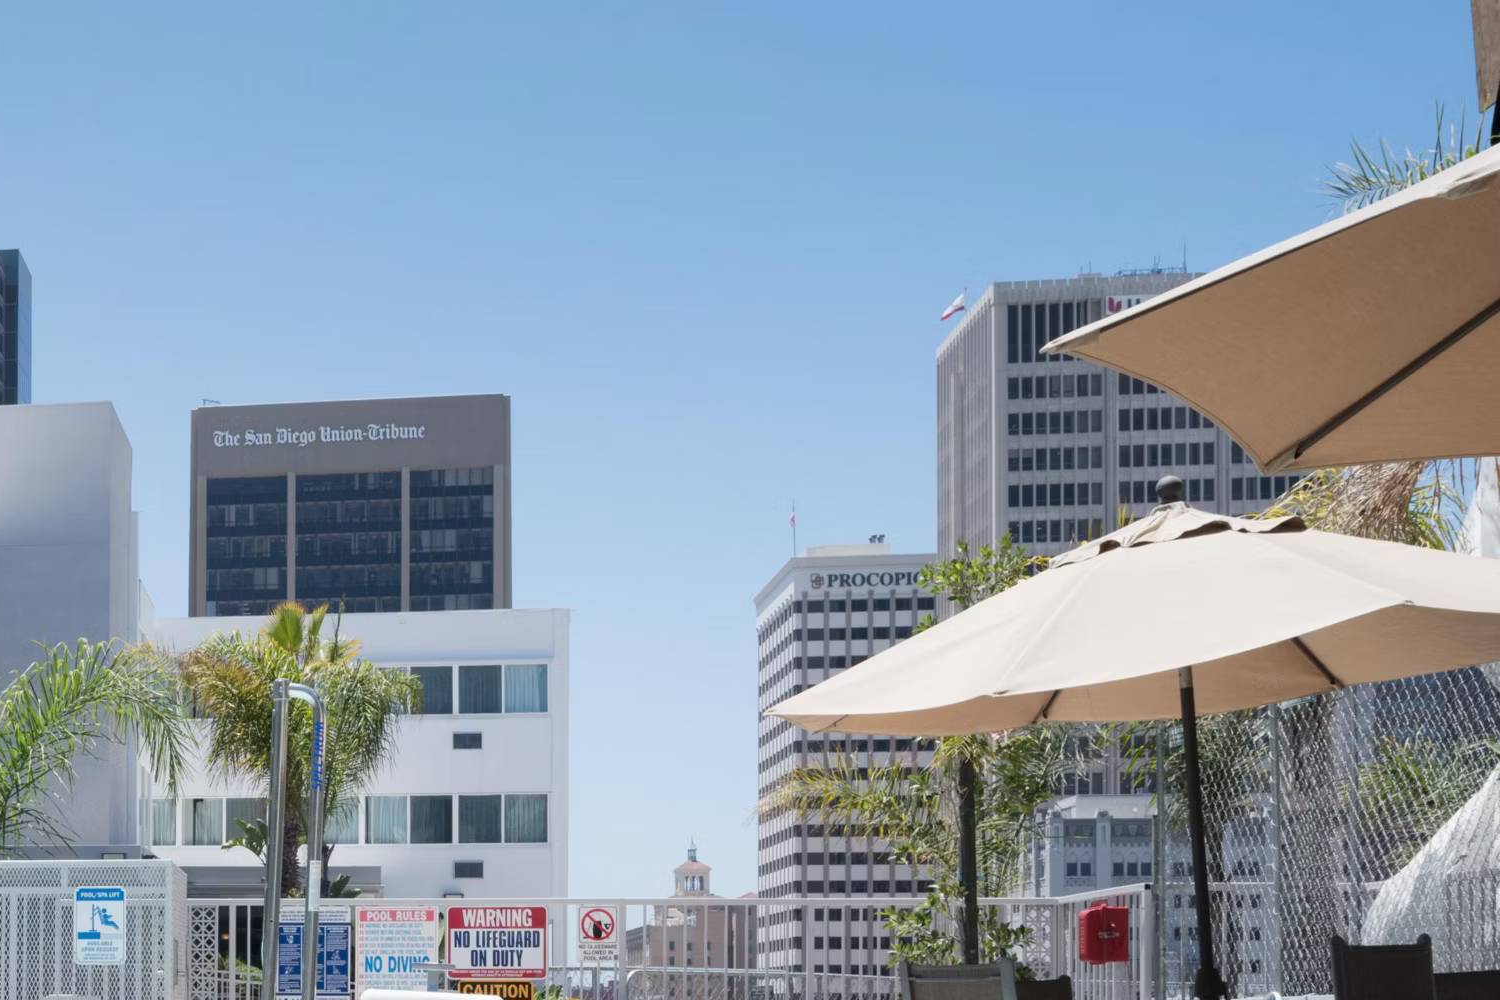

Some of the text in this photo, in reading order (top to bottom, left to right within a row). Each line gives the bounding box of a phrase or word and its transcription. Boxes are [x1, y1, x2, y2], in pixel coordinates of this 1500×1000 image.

[212, 424, 425, 447] The San Diego Union-Tribune
[366, 912, 427, 921] POOL RULES
[462, 909, 532, 927] WARNING
[454, 931, 540, 948] NO LIFEGUARD
[365, 956, 382, 972] NO
[471, 950, 523, 967] ON DUTY
[463, 984, 529, 998] CAUTION
